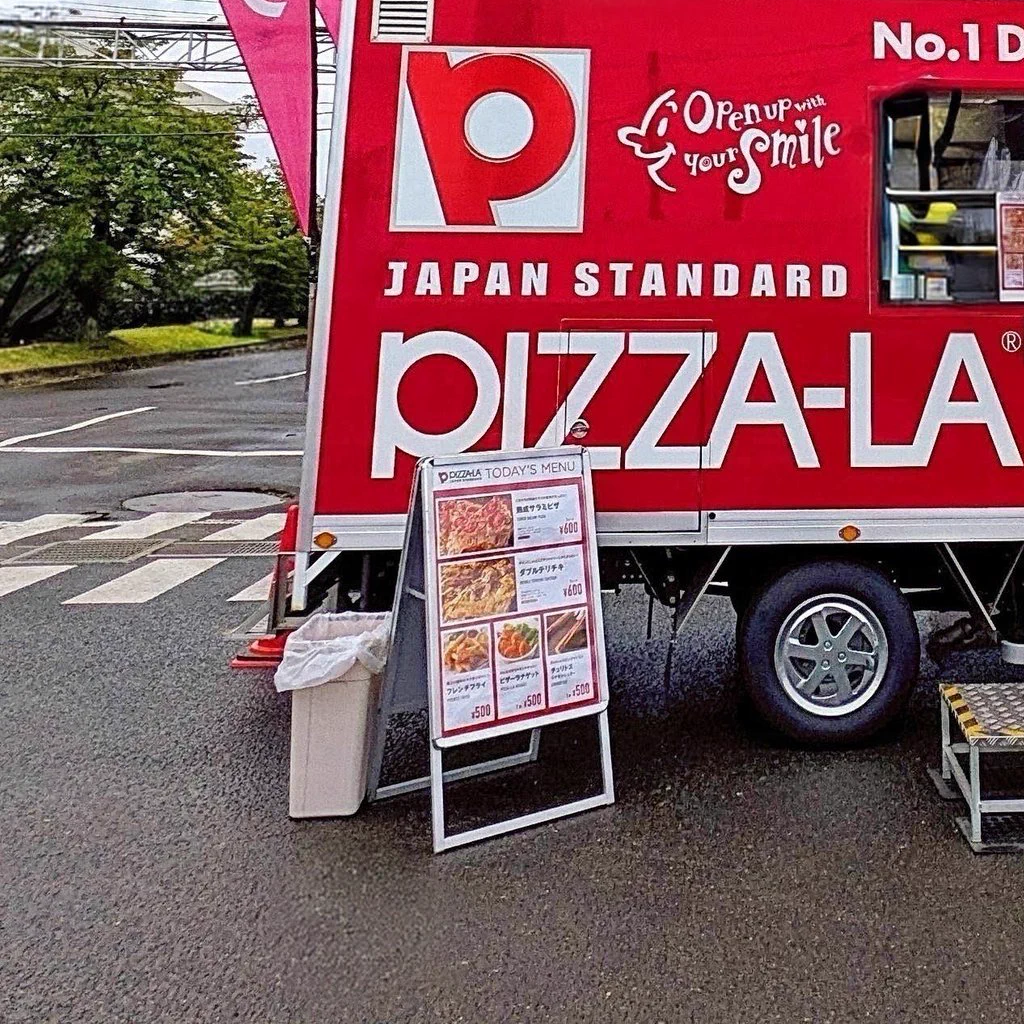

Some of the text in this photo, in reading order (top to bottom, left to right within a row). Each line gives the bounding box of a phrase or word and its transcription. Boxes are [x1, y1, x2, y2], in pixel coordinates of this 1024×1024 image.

[873, 21, 981, 61] No.1
[683, 90, 761, 134] Open
[794, 94, 827, 112] with
[684, 115, 841, 195] your Smile
[383, 261, 848, 298] JAPAN STANDARD
[485, 465, 538, 479] TODAY'S
[541, 461, 575, 474] MENU
[559, 522, 579, 535] ¥600
[563, 583, 583, 597] ¥600
[572, 682, 591, 697] ¥500
[523, 693, 542, 708] ¥500
[471, 704, 491, 719] ¥500
